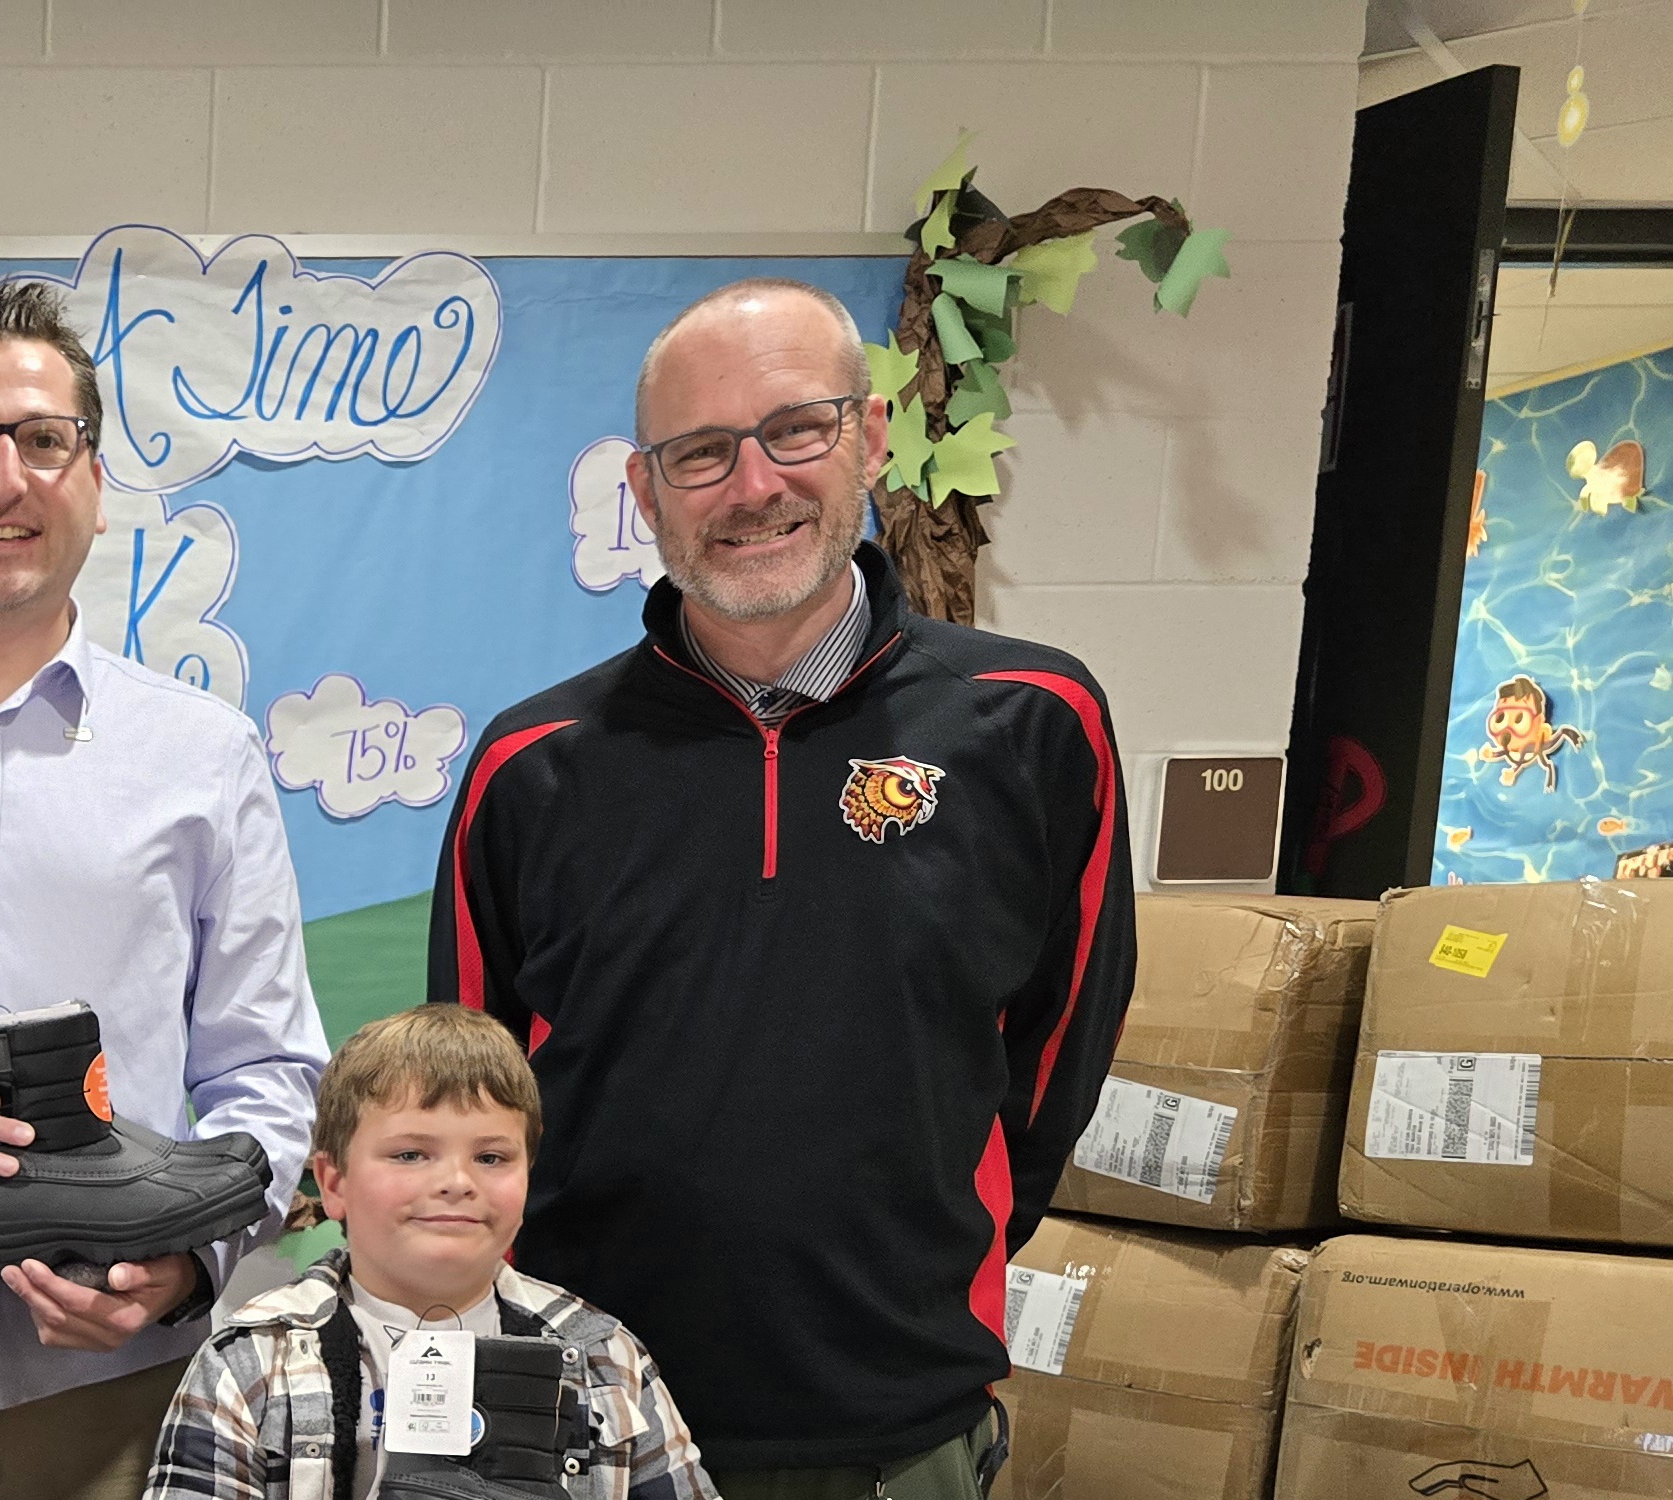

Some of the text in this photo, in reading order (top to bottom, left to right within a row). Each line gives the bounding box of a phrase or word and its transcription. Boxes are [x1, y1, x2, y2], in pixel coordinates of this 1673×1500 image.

[333, 722, 417, 783] 75%
[1201, 769, 1243, 792] 100
[1341, 1270, 1526, 1301] www.operationwarm.org
[1353, 1340, 1482, 1391] INSIDE
